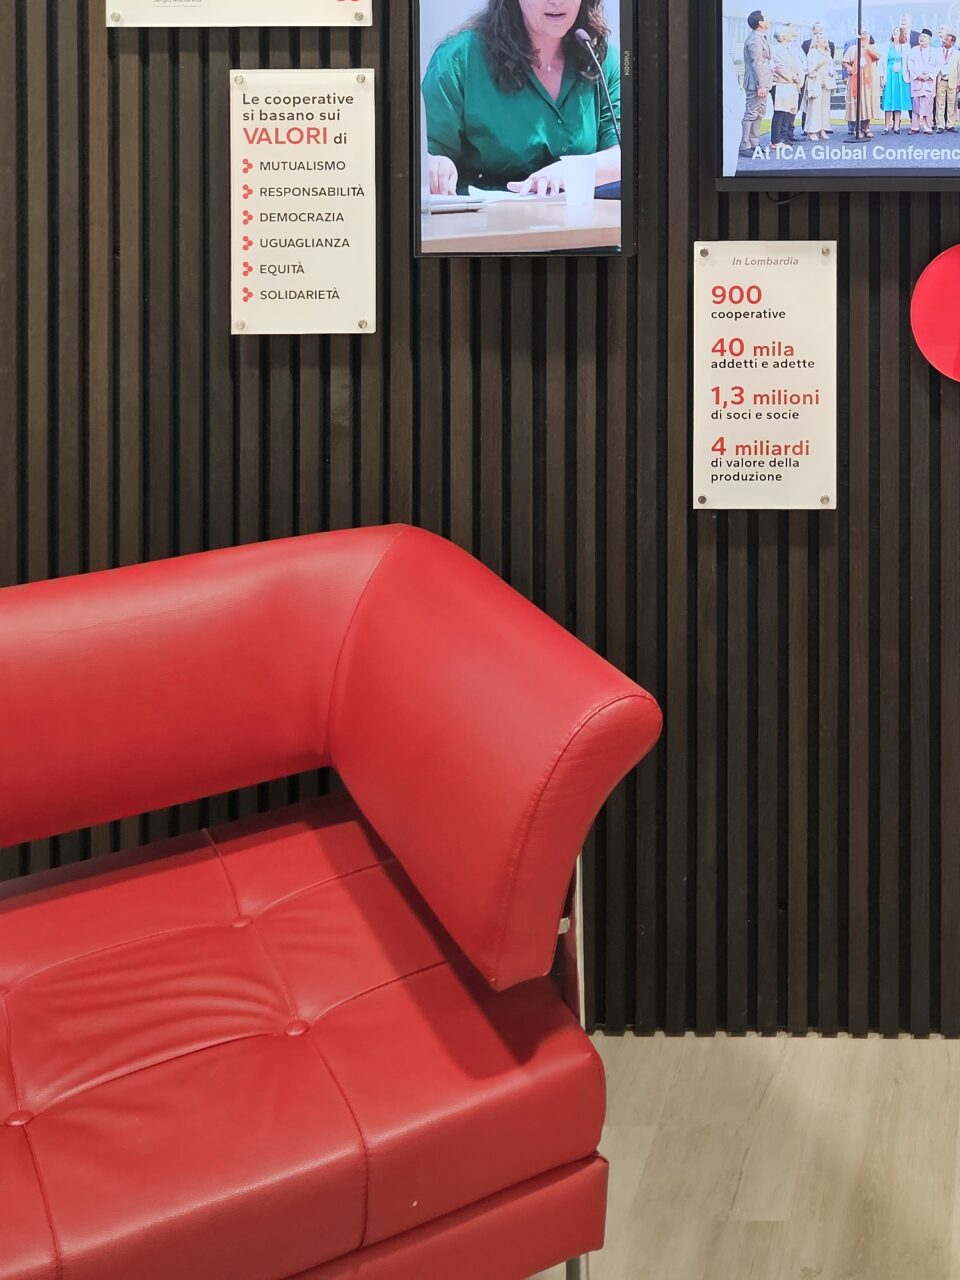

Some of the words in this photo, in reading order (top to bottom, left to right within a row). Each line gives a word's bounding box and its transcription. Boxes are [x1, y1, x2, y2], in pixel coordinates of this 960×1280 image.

[243, 93, 259, 105] Le
[265, 93, 354, 107] cooperative
[243, 109, 254, 121] si
[259, 109, 314, 121] basano
[320, 109, 340, 121] sui
[243, 127, 327, 144] VALORI
[334, 132, 347, 144] di
[752, 145, 771, 160] At
[776, 145, 807, 160] ICA
[811, 145, 867, 160] Global
[260, 161, 346, 171] MUTUALISMO
[260, 184, 365, 197] RESPONSABILITÀ
[260, 212, 344, 222] DEMOCRAZIA
[260, 238, 350, 248] UGUAGLIANZA
[732, 257, 742, 265] In
[745, 257, 799, 265] Lombardia
[260, 262, 304, 276] EQUITÀ
[260, 287, 340, 300] SOLIDARIETÀ
[712, 285, 762, 304] 900
[711, 309, 786, 321] cooperative
[711, 337, 744, 357] 40
[753, 341, 794, 357] mila
[711, 358, 757, 368] addetti
[773, 359, 814, 368] adette
[711, 386, 744, 409] 1,3
[753, 389, 819, 405] milioni
[711, 410, 722, 419] di
[727, 410, 751, 420] soci
[766, 410, 799, 419] socie
[711, 437, 727, 455] 4
[735, 440, 809, 456] miliardi
[711, 457, 722, 467] di
[726, 458, 765, 467] valore
[769, 458, 799, 467] della
[711, 472, 782, 483] produzione
